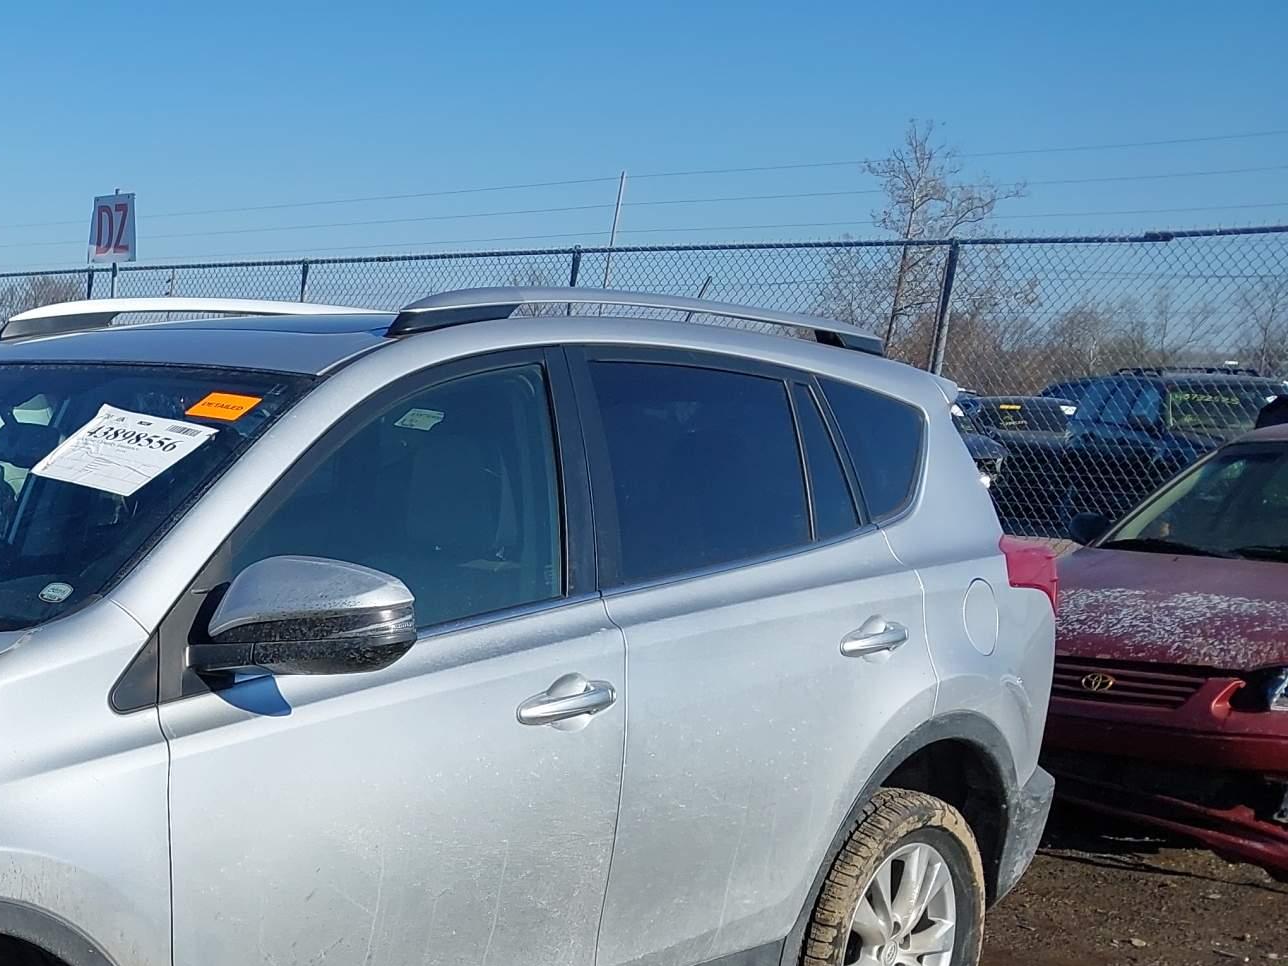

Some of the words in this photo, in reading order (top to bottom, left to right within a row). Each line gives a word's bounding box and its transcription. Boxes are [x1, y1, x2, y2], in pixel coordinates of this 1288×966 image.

[95, 203, 129, 255] DZ
[201, 401, 244, 411] DETAILED
[87, 424, 184, 453] 43898556
